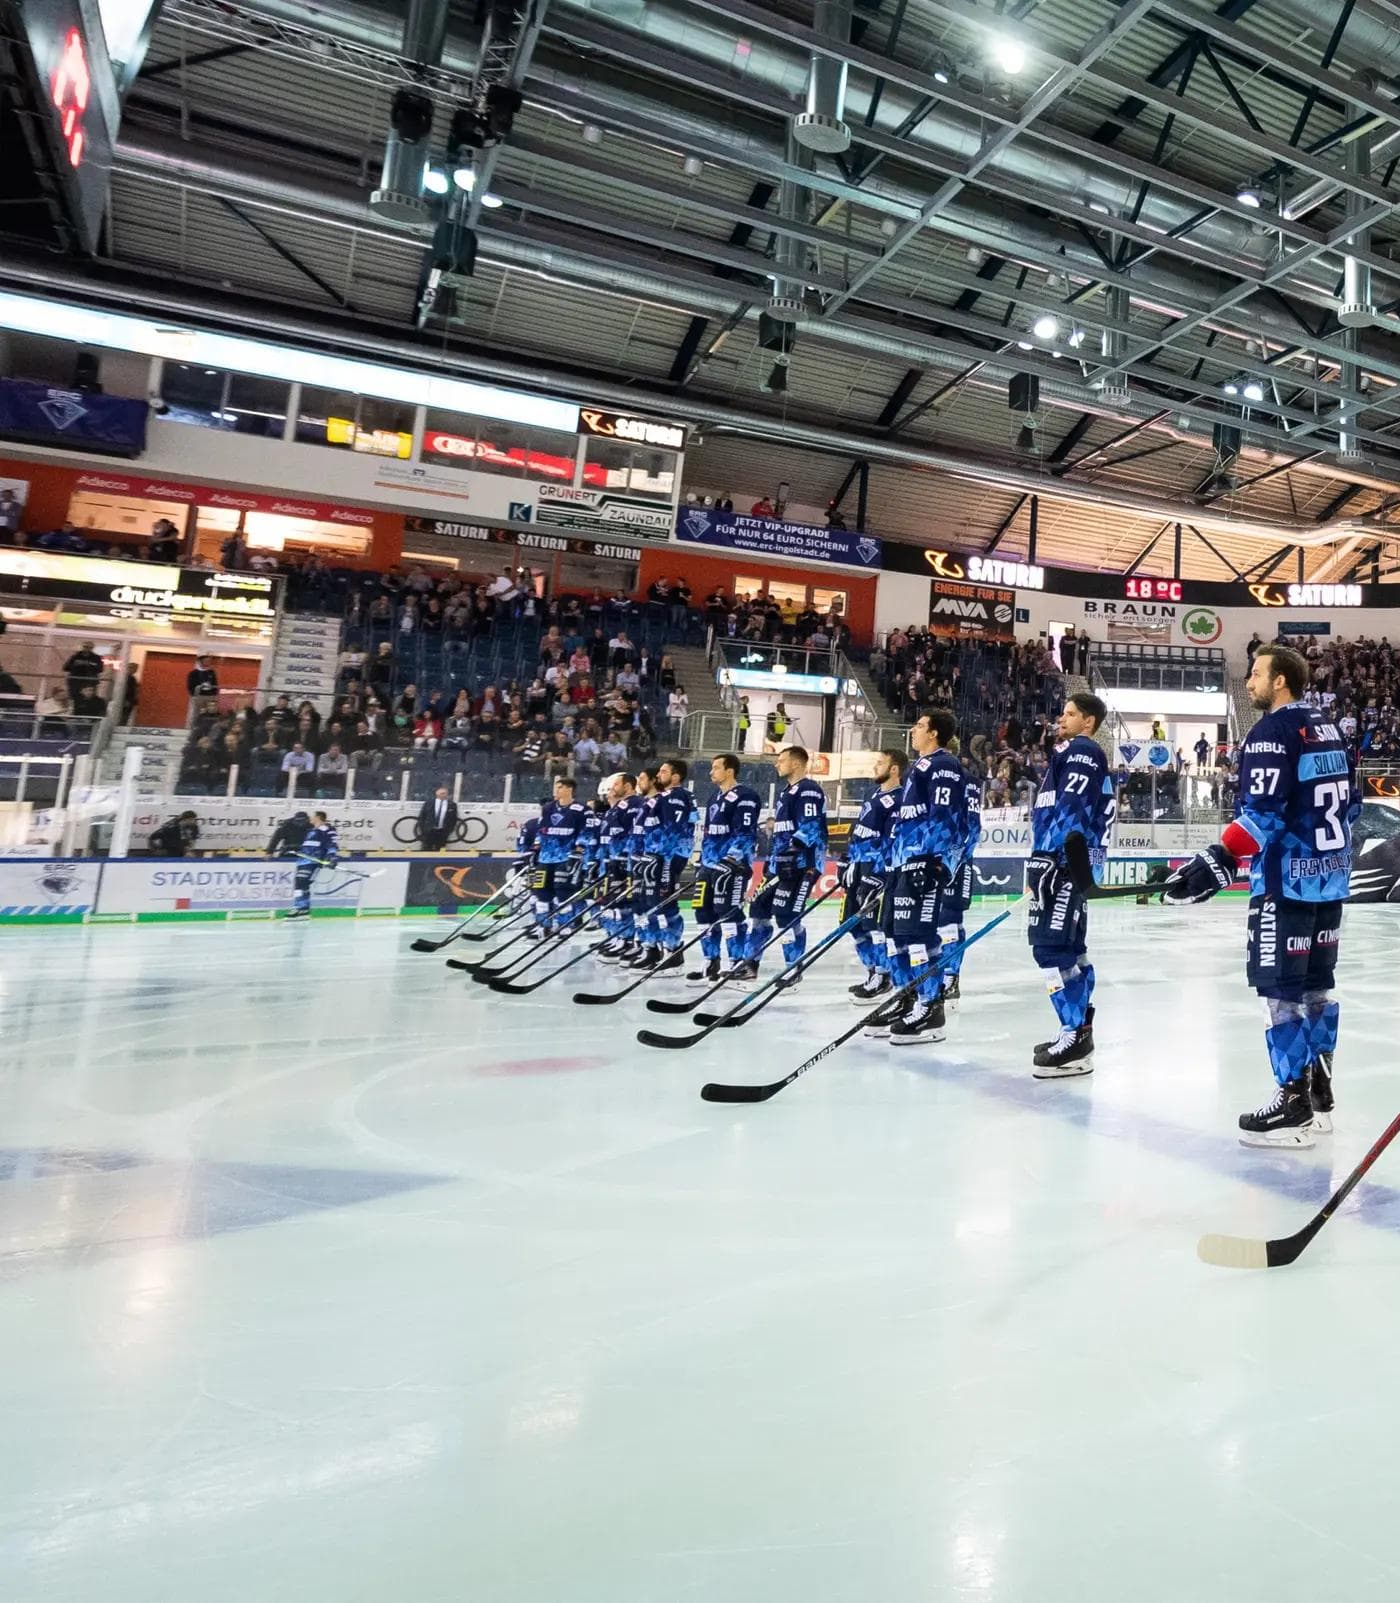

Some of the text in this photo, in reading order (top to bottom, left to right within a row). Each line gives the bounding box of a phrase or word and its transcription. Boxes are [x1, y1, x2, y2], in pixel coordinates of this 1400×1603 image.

[77, 475, 130, 491] Adecco
[145, 484, 195, 499] Adecco
[209, 492, 258, 508] Adecco
[271, 501, 317, 517] Adecco
[330, 509, 374, 524] Adecco
[513, 506, 526, 520] K
[434, 521, 490, 540] SATURN
[735, 517, 830, 539] JETZT VIP-UPGRADE
[517, 533, 568, 550] SATURN
[716, 524, 849, 552] FÜR NUR 64 EURO SICHERN!
[594, 544, 641, 560] SATURN
[734, 538, 831, 559] www.erc-ingolstadt.de
[968, 556, 1044, 590] SATURN
[935, 582, 975, 597] ENERGIE
[997, 591, 1012, 602] SIE
[1288, 584, 1362, 606] SATURN
[1084, 601, 1176, 618] BRAUN
[1123, 615, 1176, 624] entsorgen
[1064, 773, 1089, 795] 27
[1250, 768, 1280, 795] 37
[934, 786, 951, 805] 13
[674, 811, 683, 822] 7
[804, 803, 817, 816] 61
[744, 812, 751, 825] 5
[152, 870, 294, 887] STADTWERK
[193, 887, 294, 900] INGOLSTAD
[1260, 903, 1276, 967] SATURN
